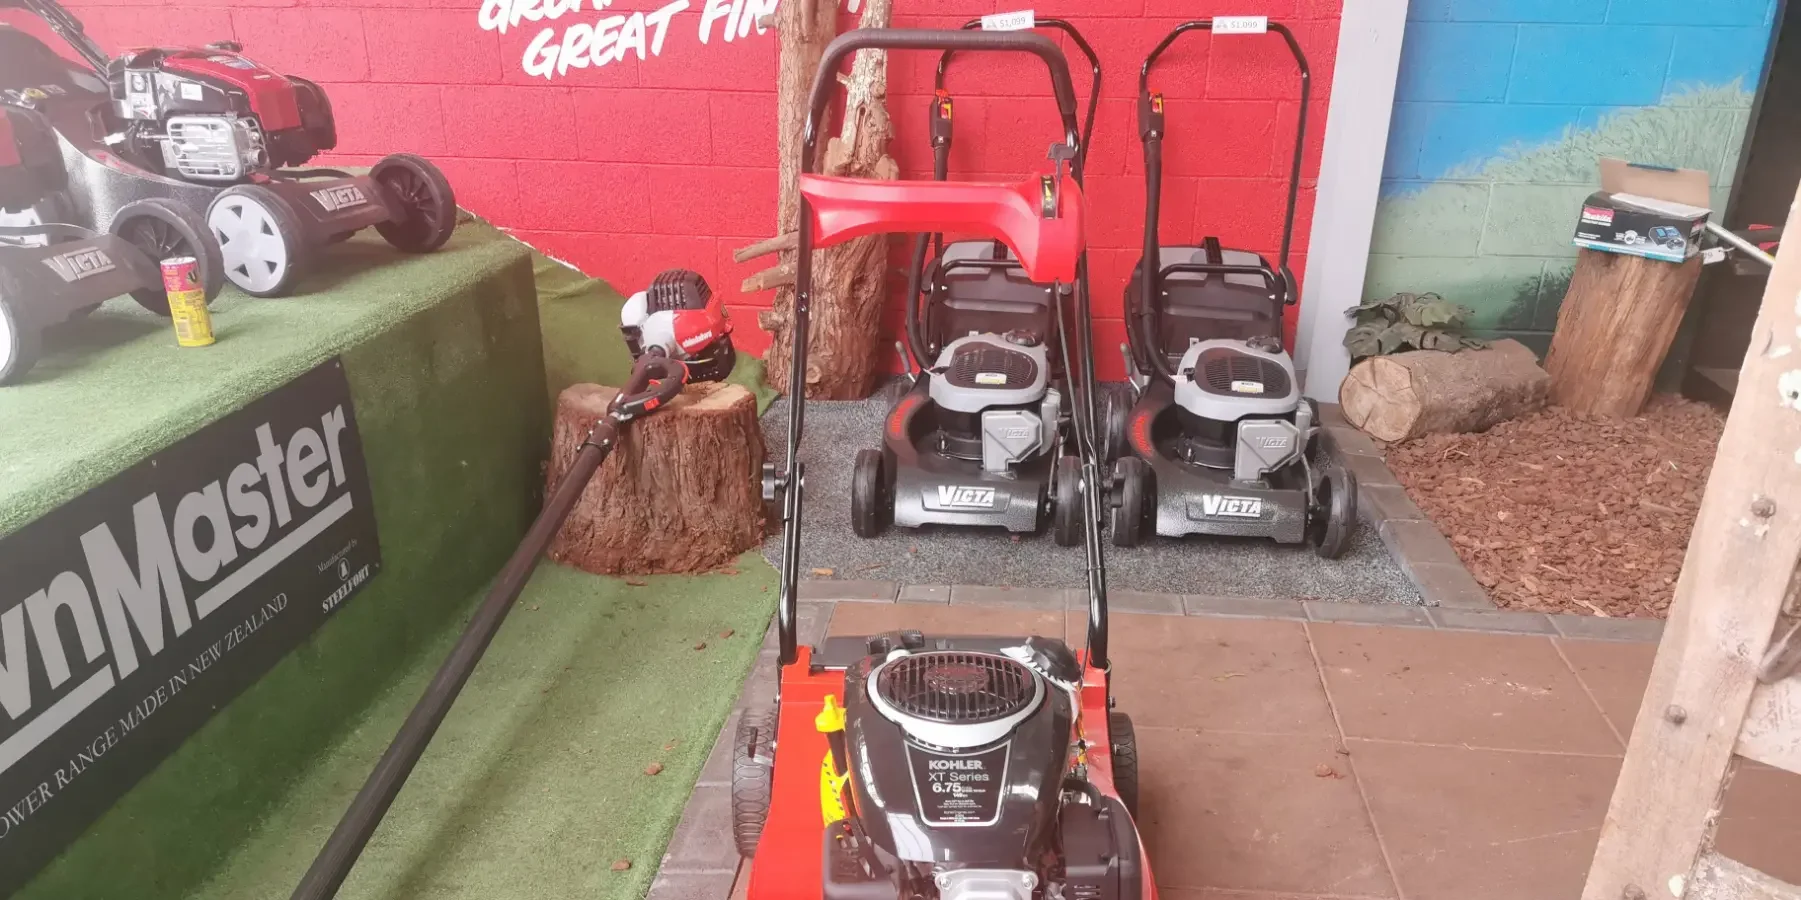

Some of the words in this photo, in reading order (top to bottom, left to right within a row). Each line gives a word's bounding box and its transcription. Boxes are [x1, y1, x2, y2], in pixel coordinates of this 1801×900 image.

[522, 5, 690, 80] GREAT
[310, 184, 368, 212] VICTA
[42, 246, 116, 283] VICTA
[999, 427, 1030, 439] VICTA
[1256, 436, 1288, 448] VICTA
[937, 485, 995, 507] VICTA
[1202, 494, 1262, 517] VICTA
[54, 727, 119, 790] RANGE
[118, 686, 169, 737] MADE
[168, 669, 189, 696] IN
[187, 640, 222, 680] NEW
[224, 592, 288, 651] ZEALAND
[928, 759, 984, 770] KOHLER
[928, 772, 946, 781] XT
[949, 772, 990, 782] Series
[932, 782, 961, 793] 6.75
